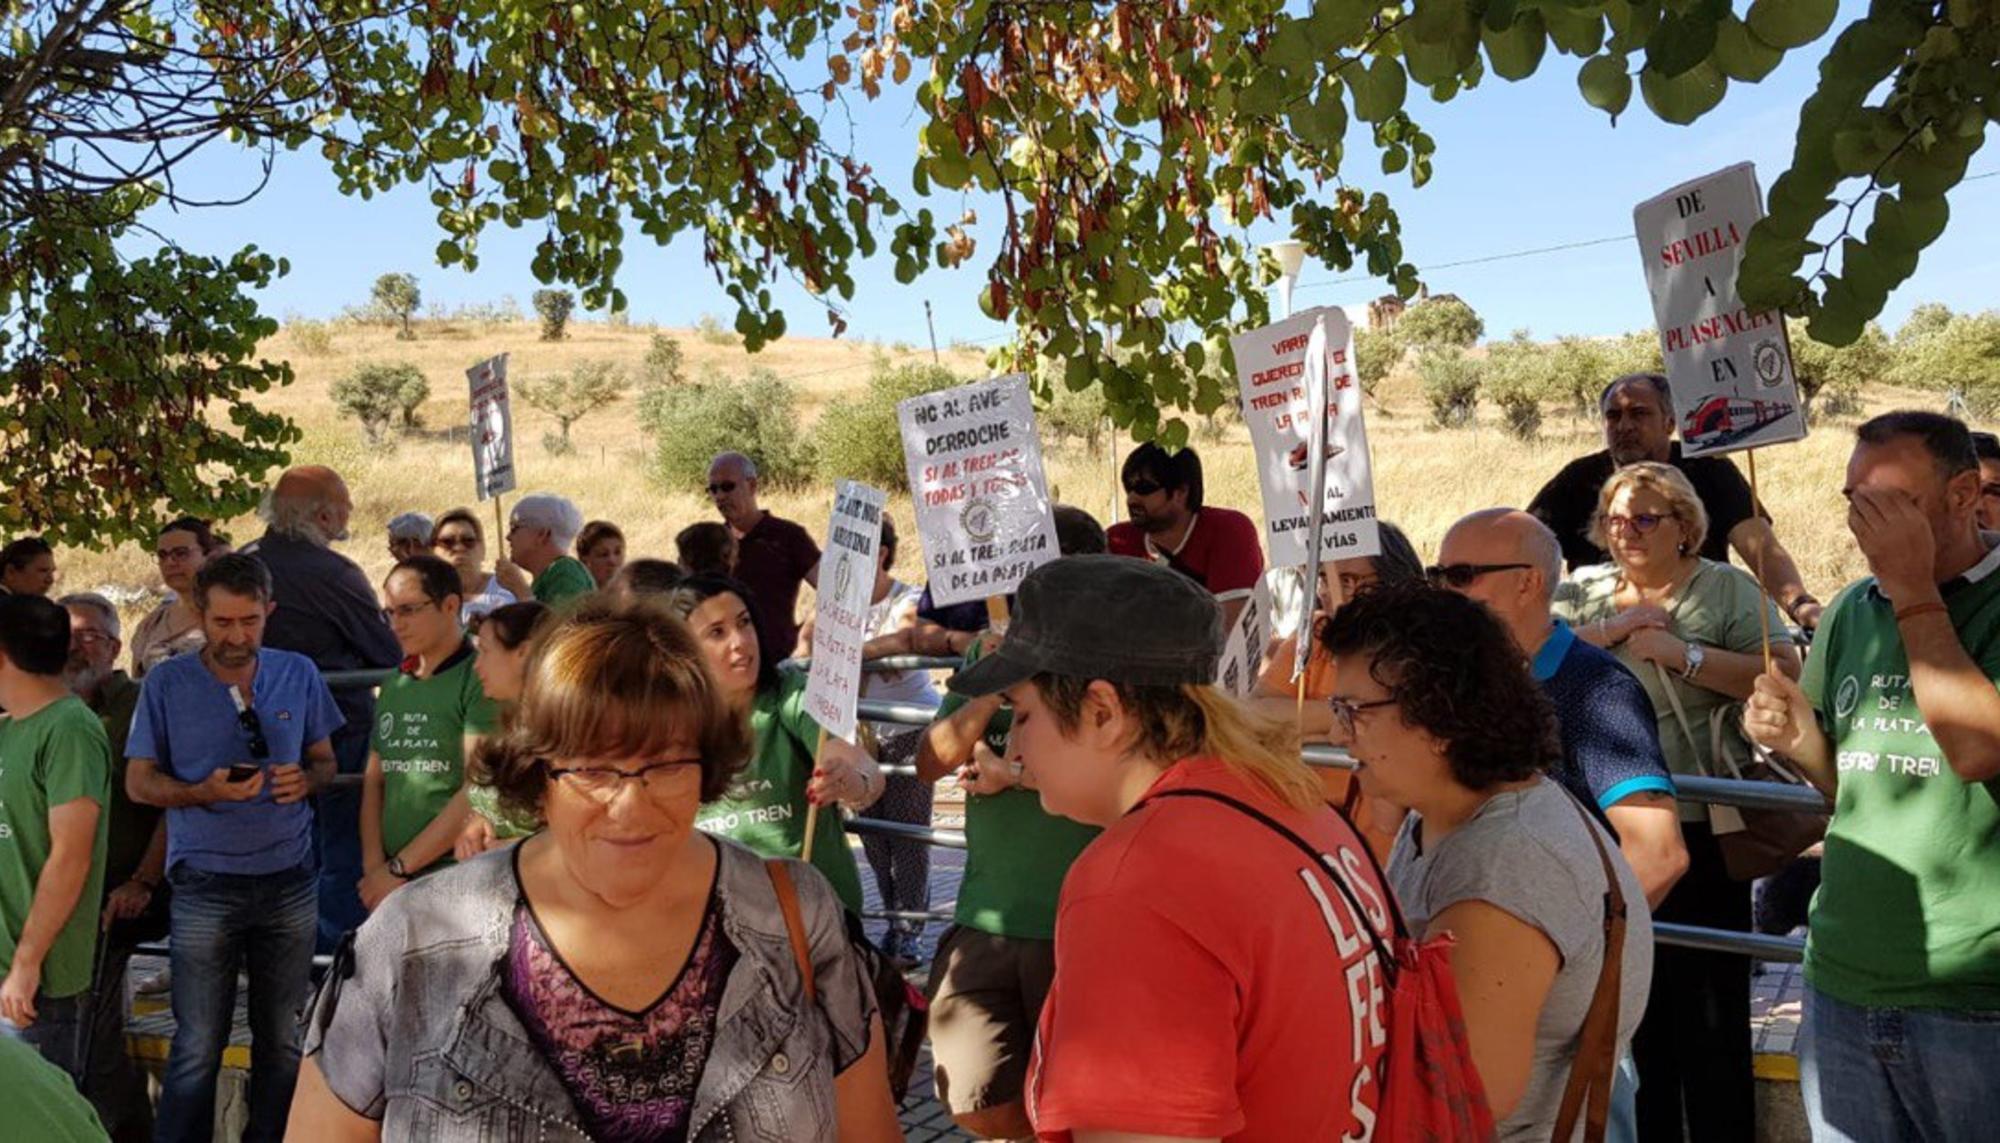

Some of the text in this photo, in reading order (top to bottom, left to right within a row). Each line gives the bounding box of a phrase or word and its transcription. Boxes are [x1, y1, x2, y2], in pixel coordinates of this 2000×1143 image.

[1676, 190, 1706, 219] DE
[1661, 222, 1740, 268] SEVILLA
[1704, 275, 1716, 296] A
[1666, 308, 1773, 351] PLASENCIA
[1252, 361, 1305, 386] QUERE
[1711, 357, 1738, 383] EN
[1251, 392, 1288, 410] TREN
[1334, 375, 1351, 390] DE
[915, 405, 938, 426] NO
[943, 399, 963, 419] AL
[1276, 414, 1292, 429] LA
[926, 420, 1010, 456] DERROCHE
[925, 466, 938, 483] SI
[942, 461, 958, 479] AL
[963, 453, 997, 474] TREN
[924, 483, 965, 507] TODAS
[1327, 486, 1343, 500] AL
[1324, 532, 1358, 550] VÍAS
[934, 553, 946, 569] SI
[951, 550, 965, 565] AL
[952, 574, 967, 590] DE
[973, 569, 988, 586] LA
[1871, 675, 1912, 689] RUTA
[1879, 696, 1900, 711] DE
[407, 726, 421, 736] DE
[1852, 717, 1931, 736] LA PLATA
[387, 739, 438, 749] LA PLATA
[415, 760, 450, 773] TREN
[1886, 754, 1940, 777] TREN
[745, 804, 793, 824] TREN
